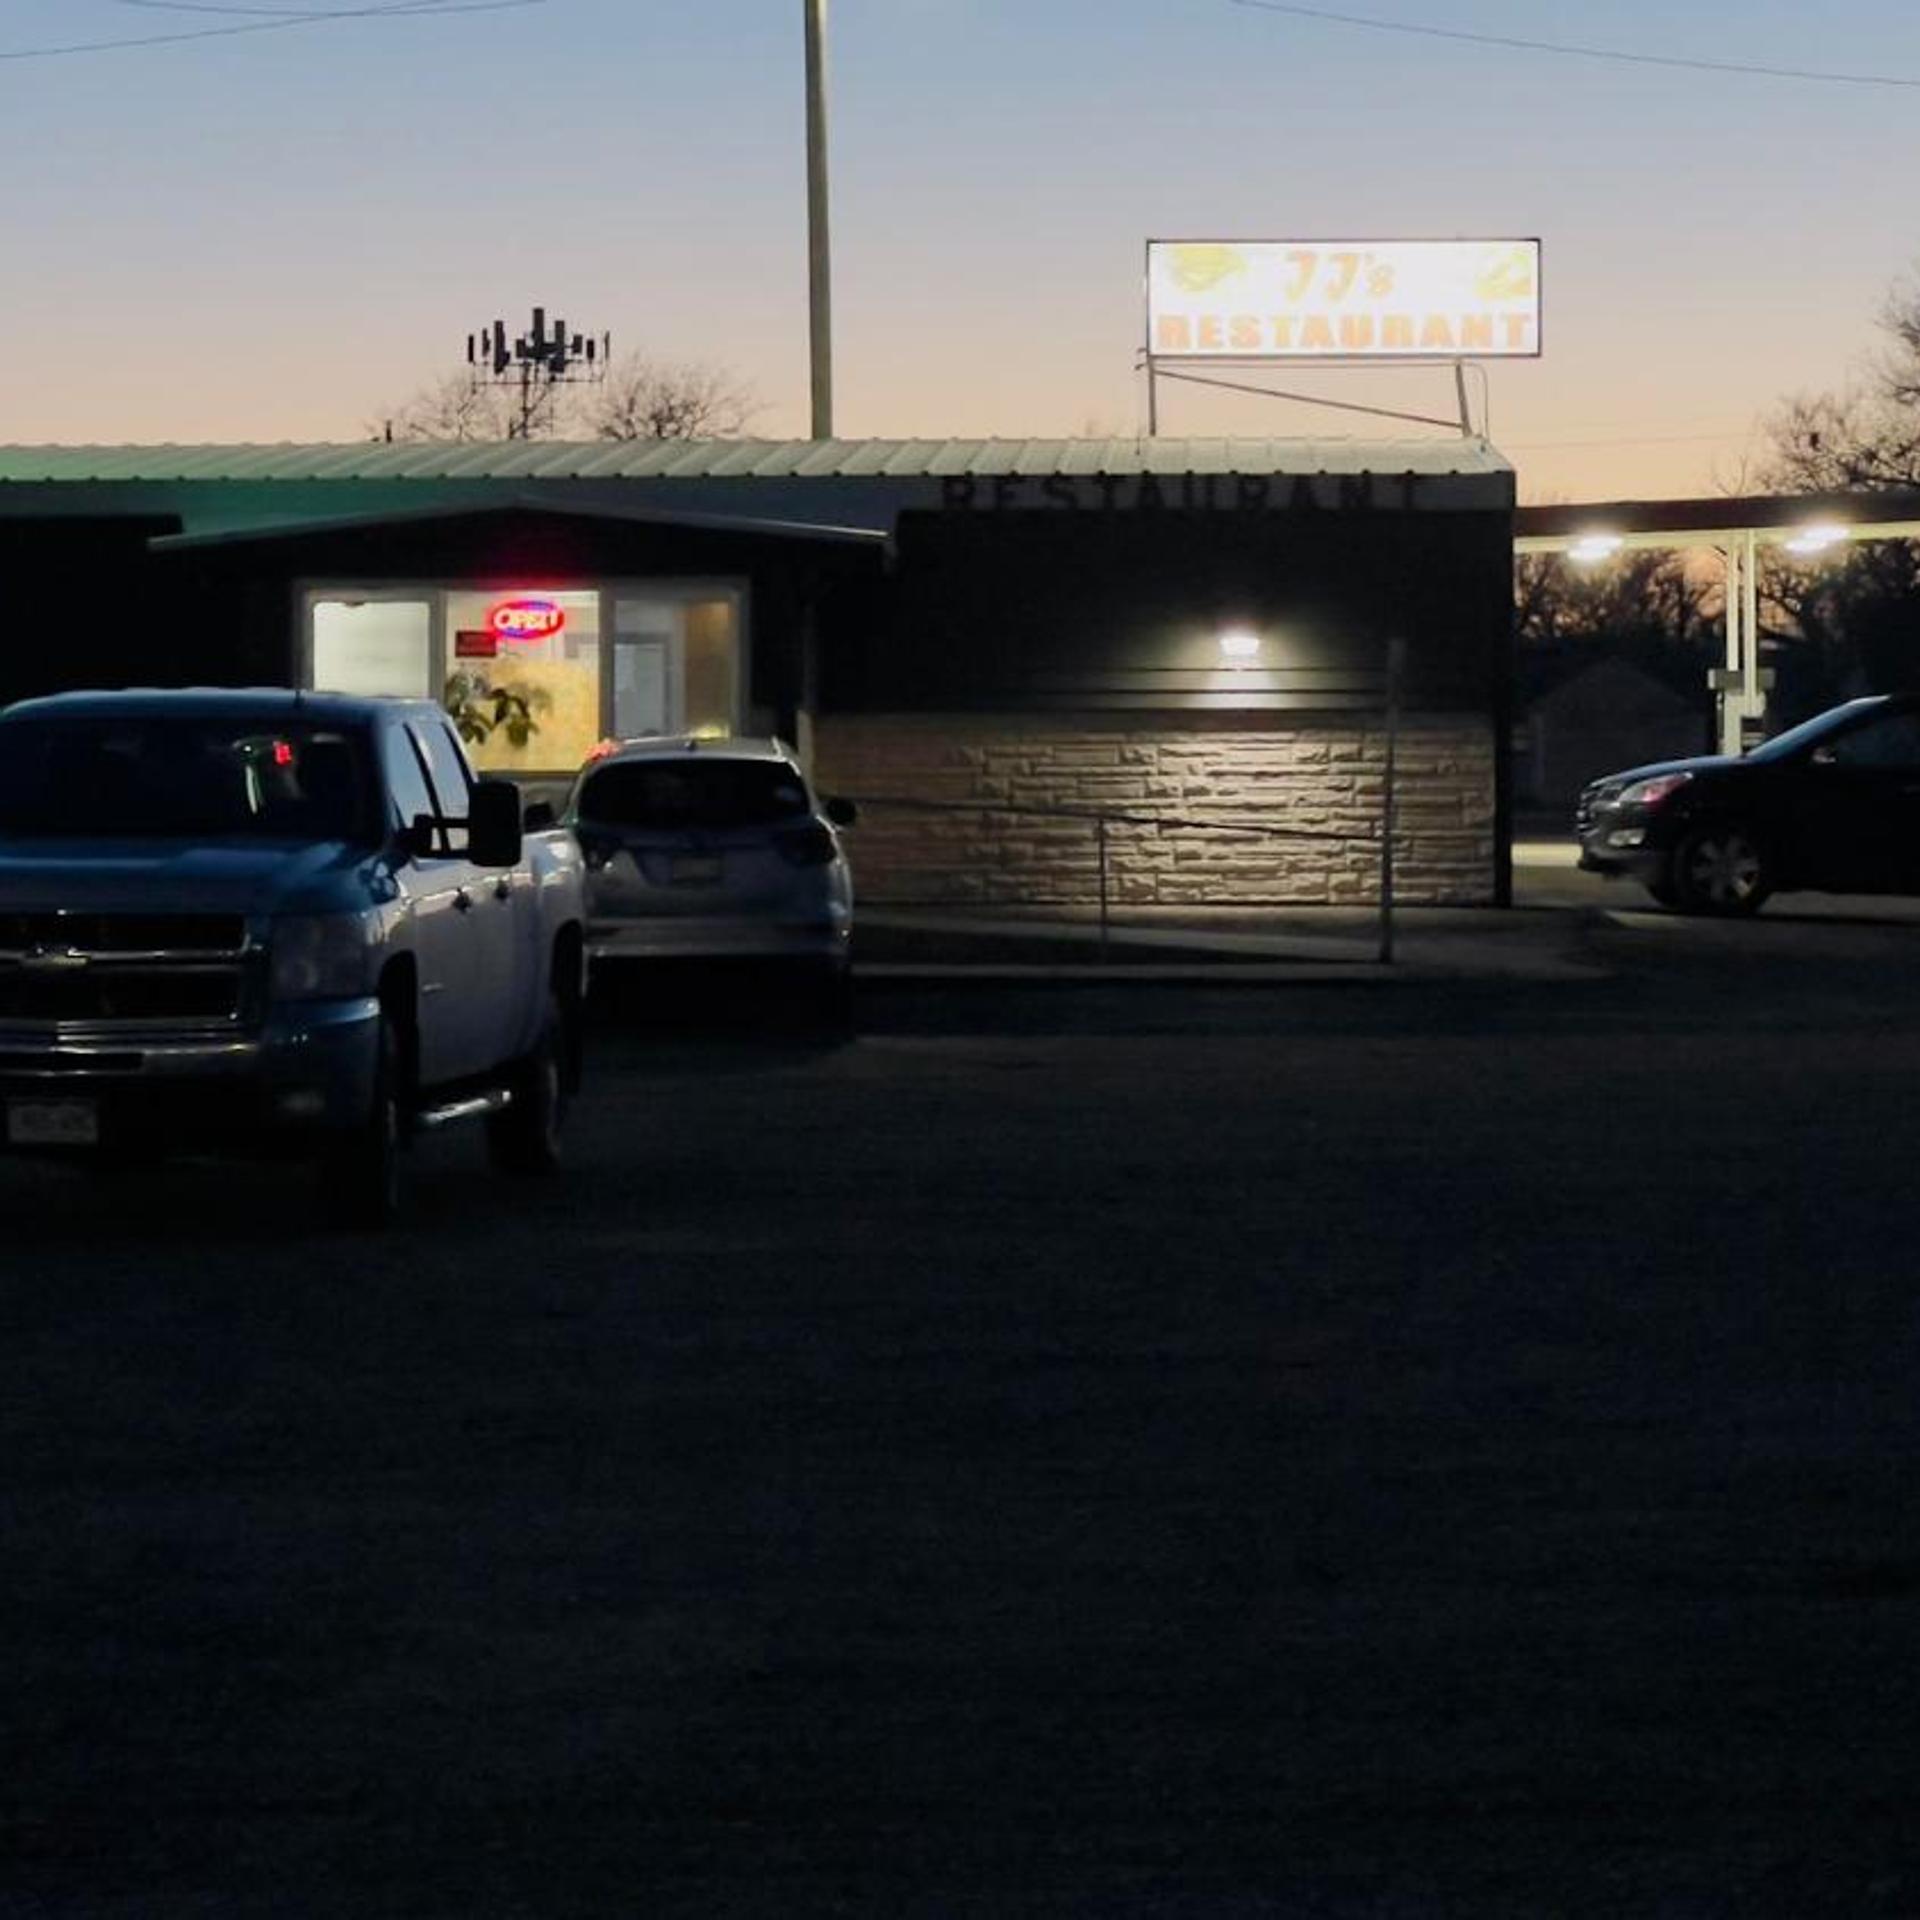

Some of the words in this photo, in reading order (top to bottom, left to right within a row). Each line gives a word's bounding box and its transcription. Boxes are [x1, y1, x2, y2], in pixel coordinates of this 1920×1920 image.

[1156, 312, 1532, 350] RESTAURANT
[942, 475, 1422, 512] RESTAURANT
[495, 607, 559, 631] OPEN
